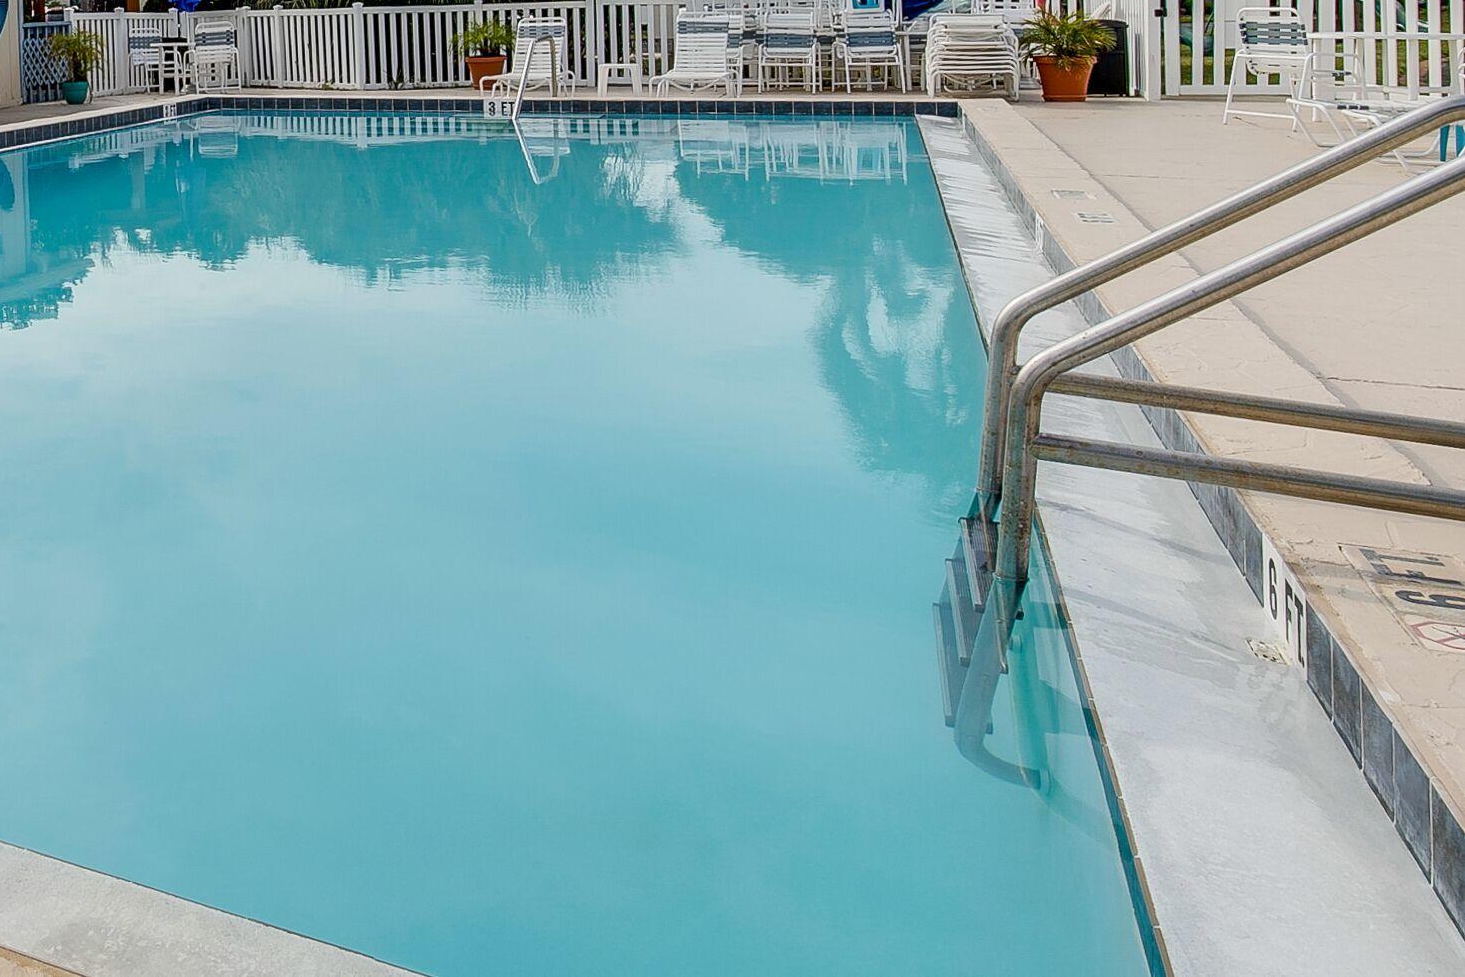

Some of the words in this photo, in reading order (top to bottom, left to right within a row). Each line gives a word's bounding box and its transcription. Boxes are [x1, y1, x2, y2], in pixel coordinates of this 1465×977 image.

[488, 101, 496, 114] 3
[1268, 558, 1278, 621] 6
[1284, 578, 1305, 668] FT.
